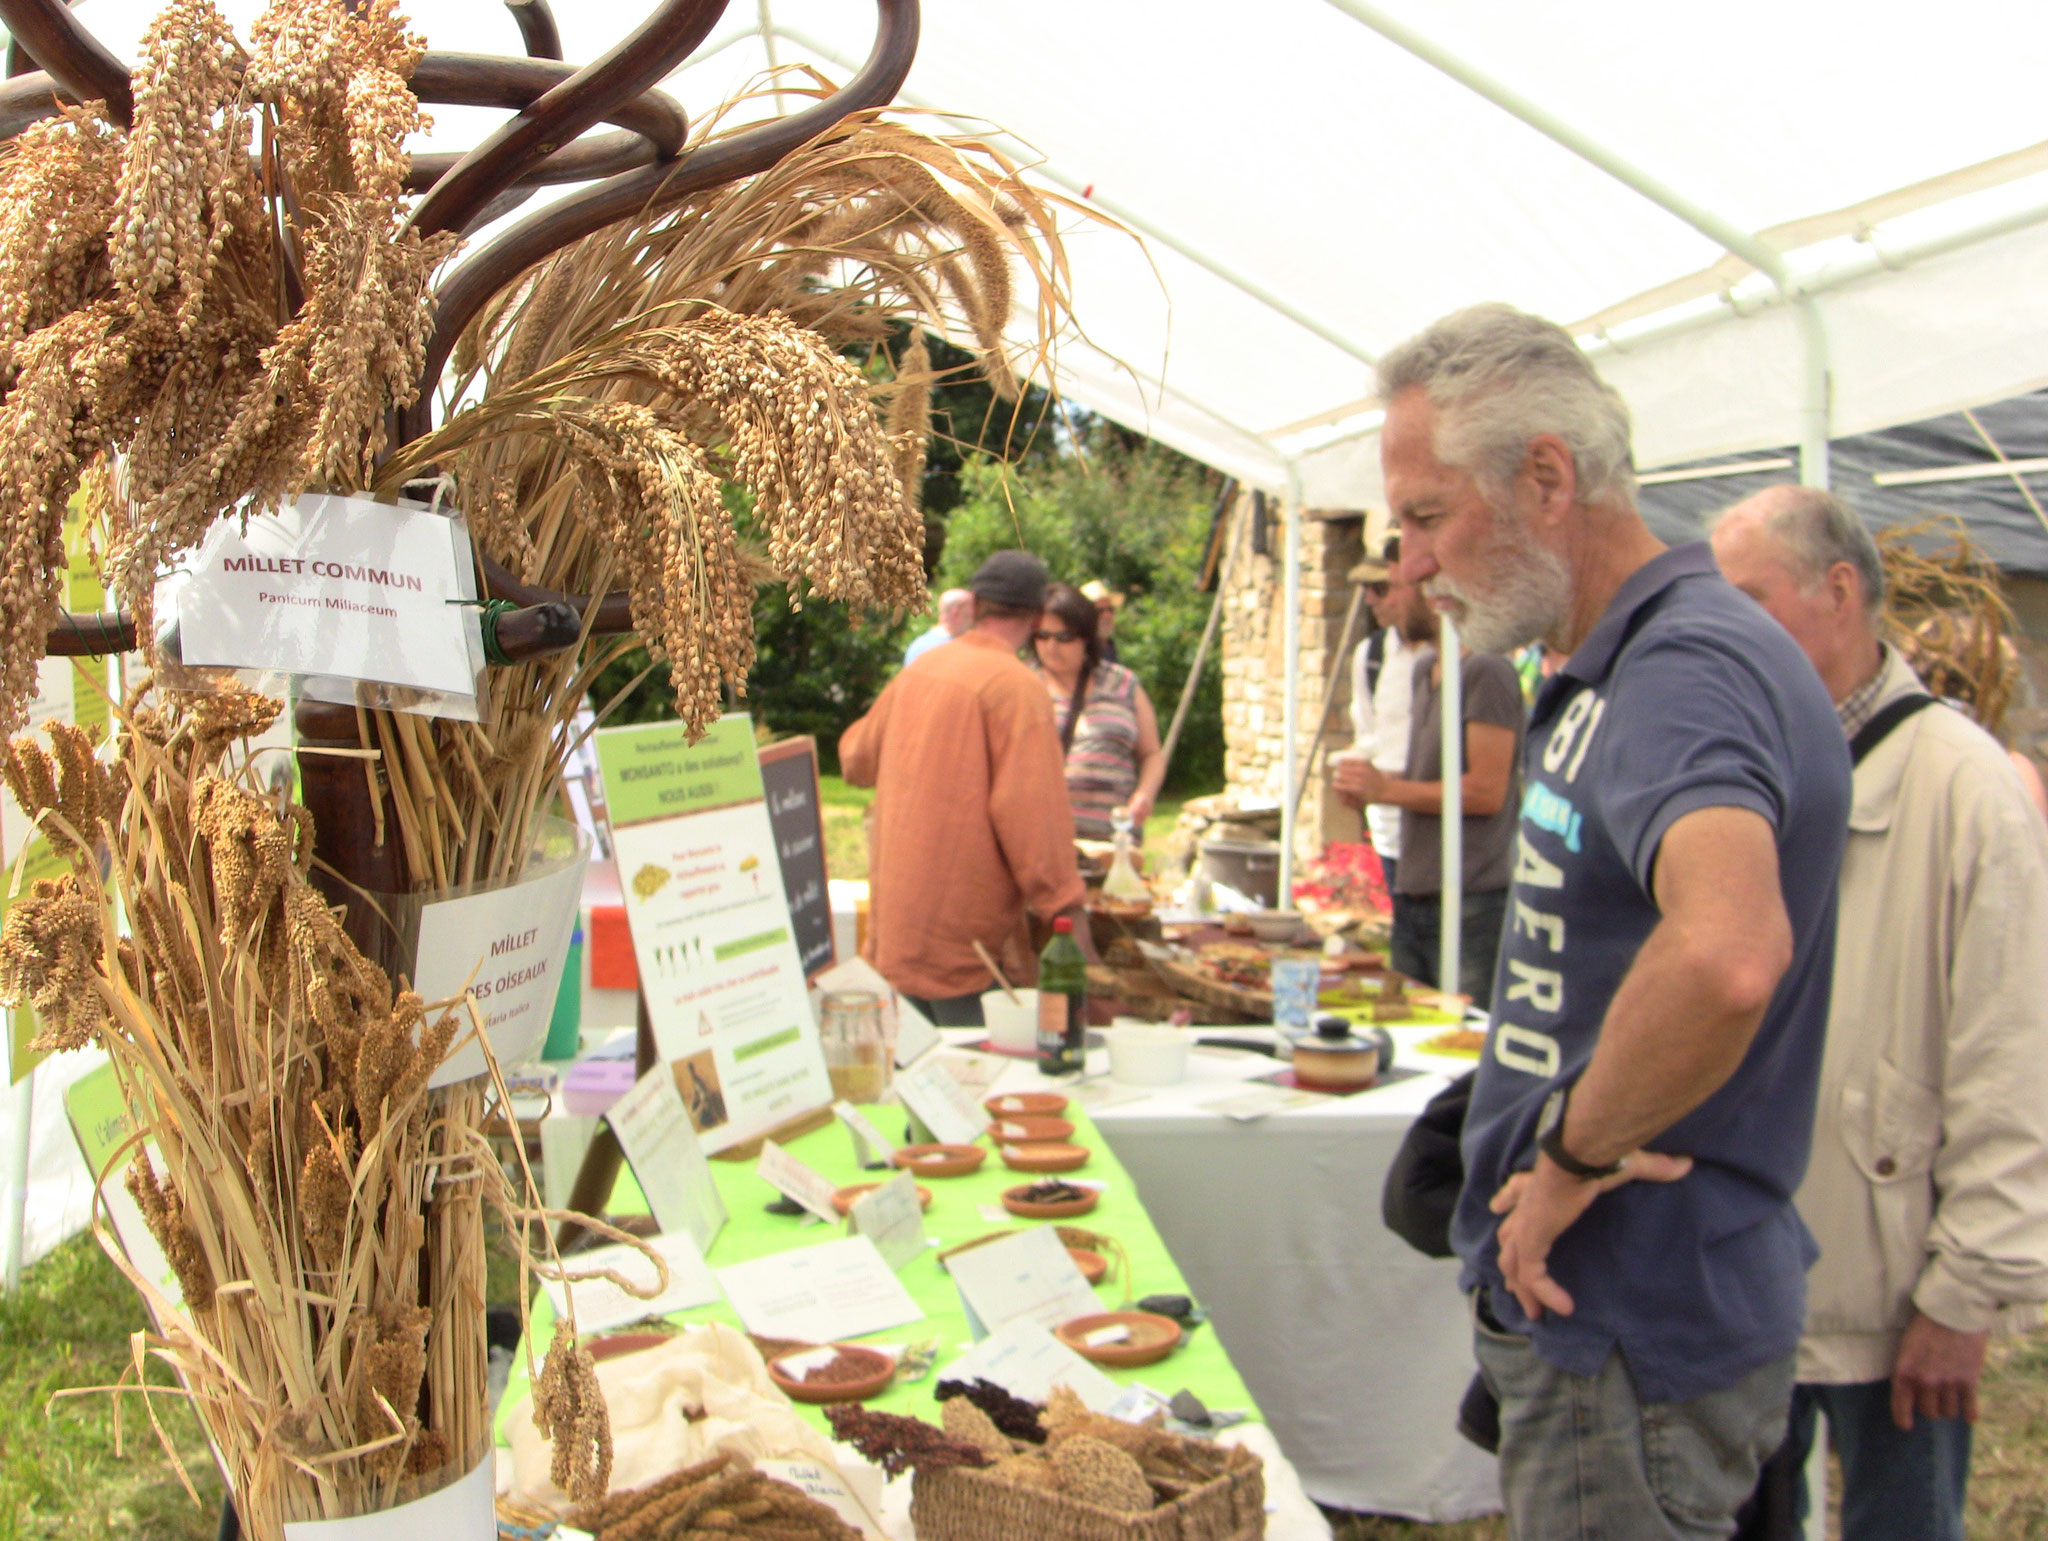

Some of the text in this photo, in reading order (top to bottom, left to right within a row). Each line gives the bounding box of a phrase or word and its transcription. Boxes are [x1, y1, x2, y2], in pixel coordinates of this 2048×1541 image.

[311, 560, 424, 593] COMMUN
[258, 592, 399, 619] Panicum Miliaceum
